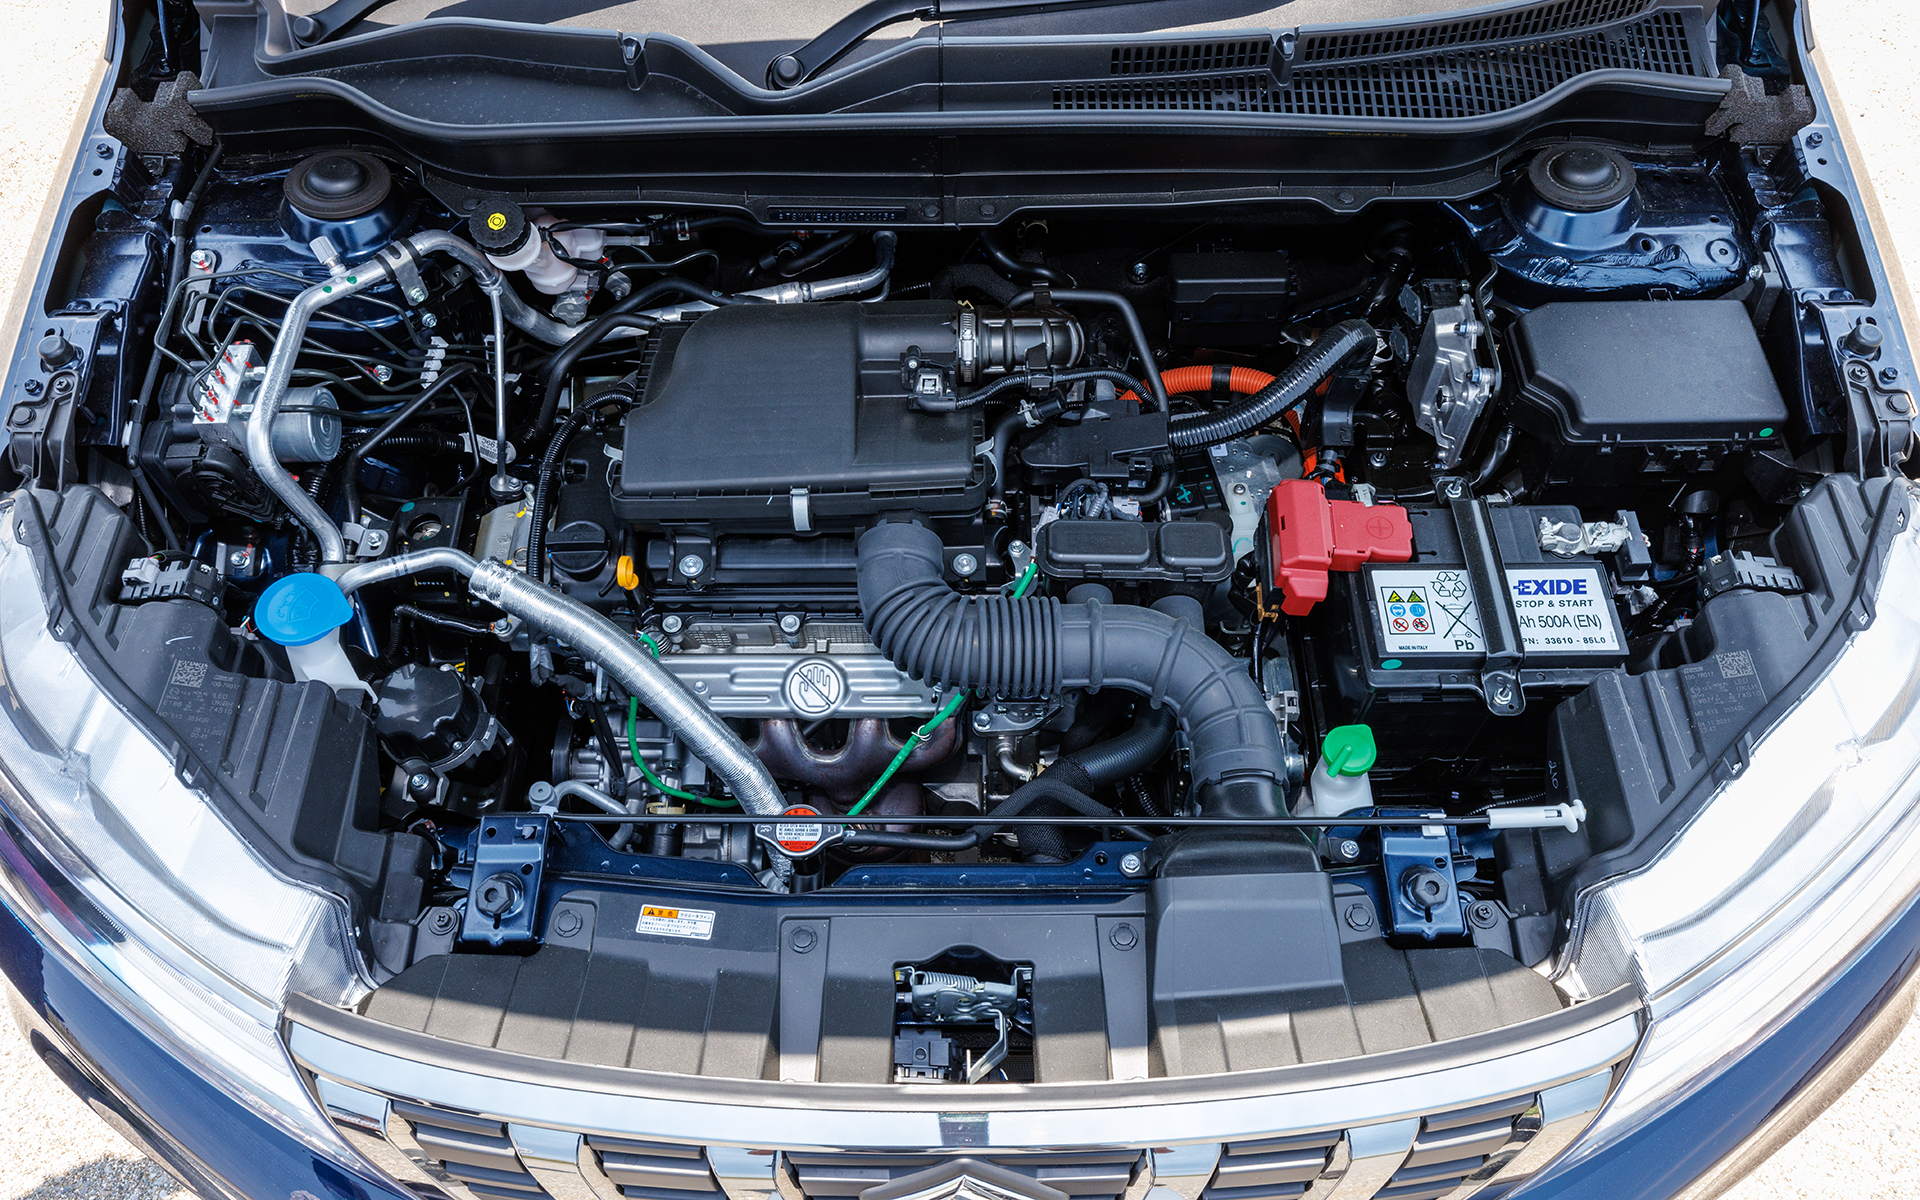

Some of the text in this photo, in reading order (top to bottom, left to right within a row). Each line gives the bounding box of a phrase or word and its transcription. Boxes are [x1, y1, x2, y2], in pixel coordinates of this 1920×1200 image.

[1515, 579, 1587, 595] EXIDE
[1515, 599, 1594, 608] STOP & START
[1538, 615, 1571, 628] 500A
[1573, 613, 1603, 631] (EN)
[1454, 639, 1475, 651] Pb
[1544, 637, 1573, 645] 33610
[1582, 636, 1606, 644] 85L0
[1733, 677, 1748, 685] LED
